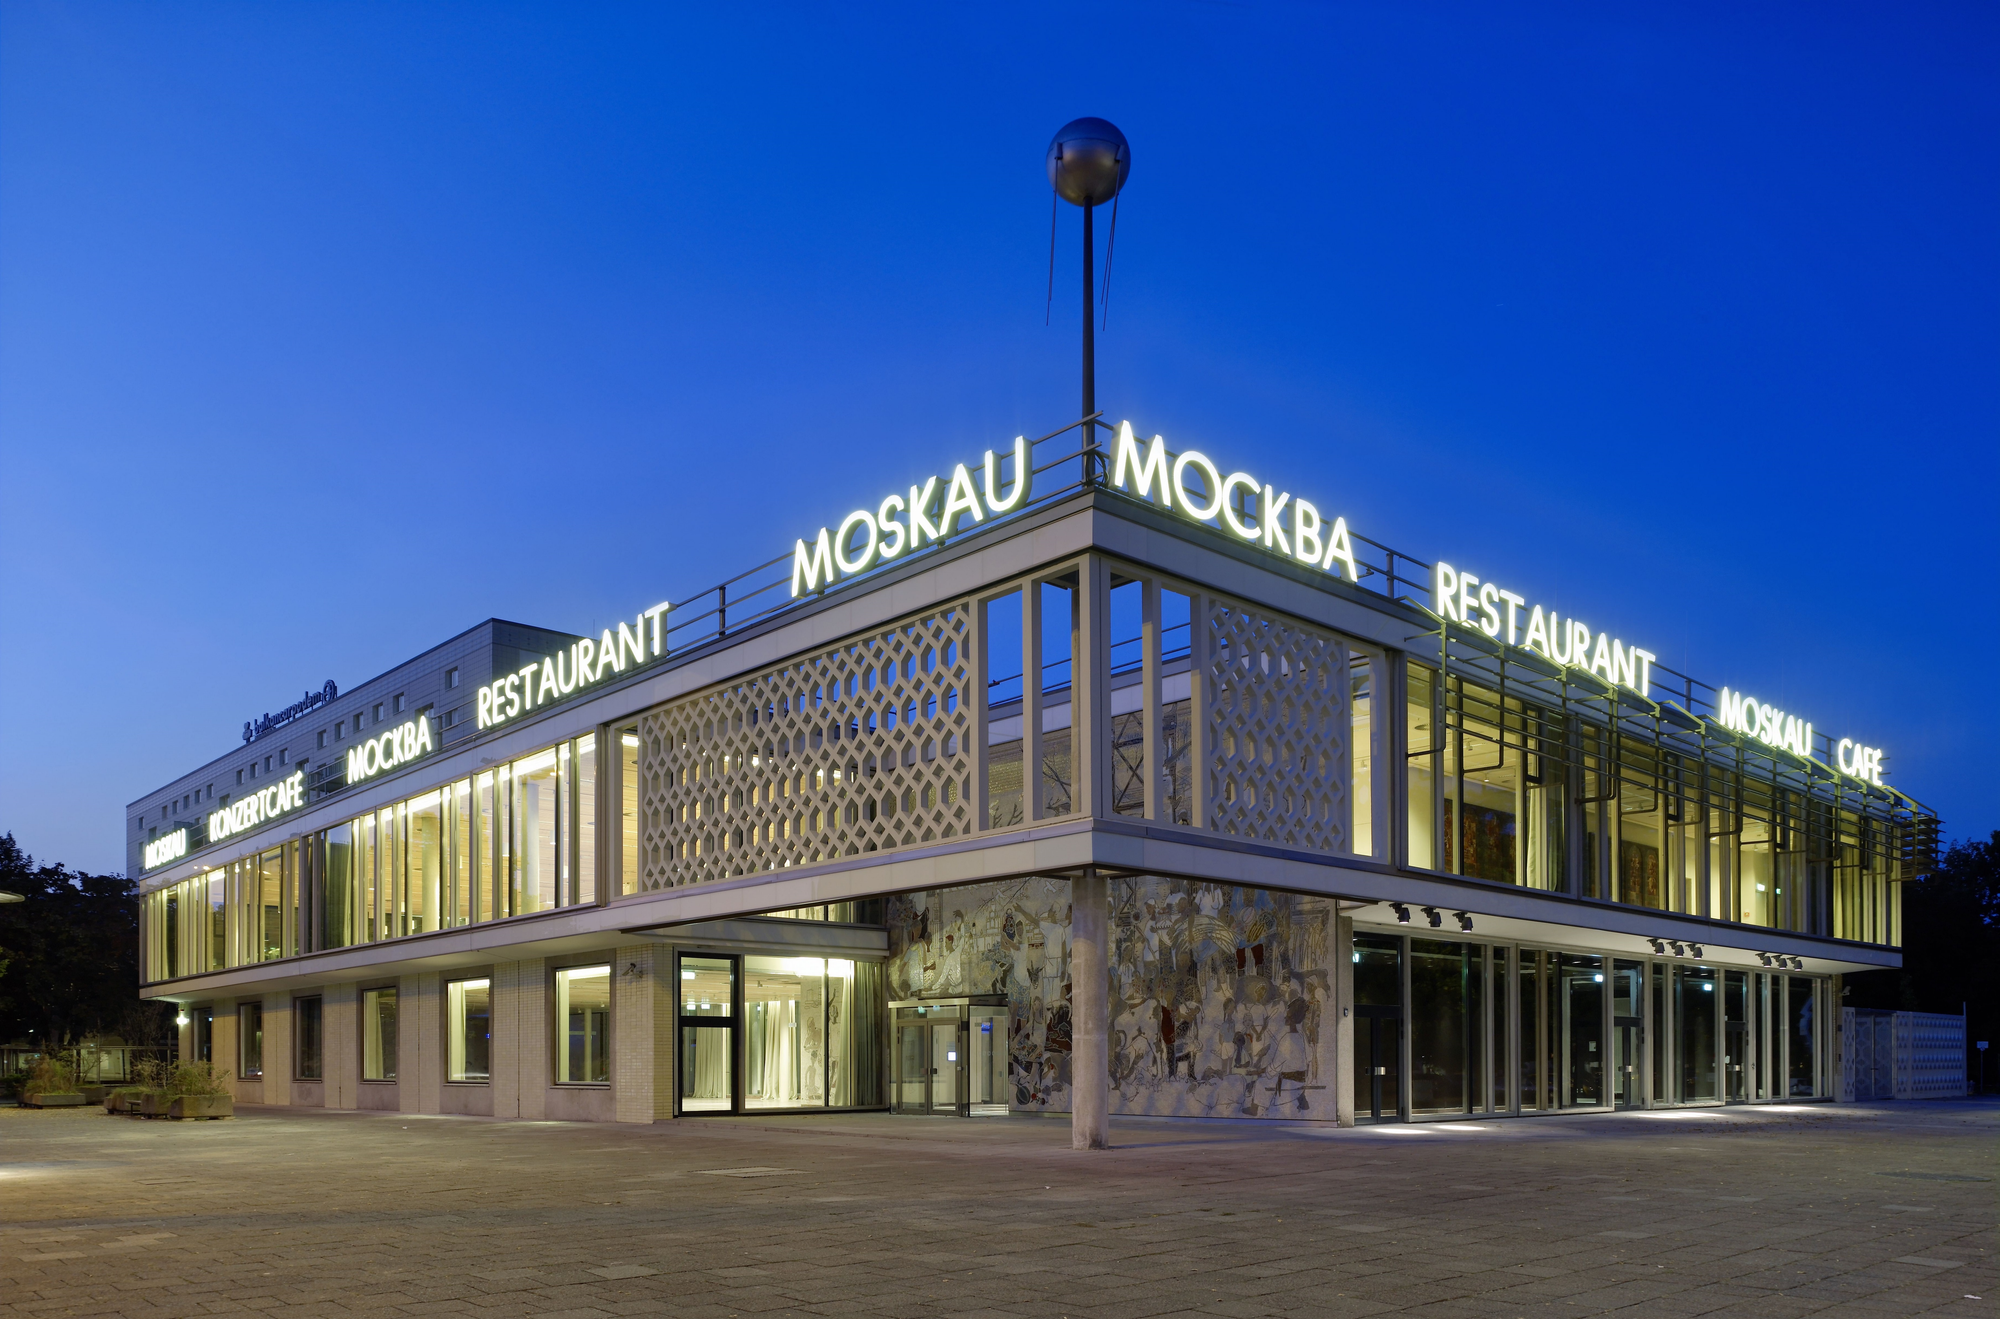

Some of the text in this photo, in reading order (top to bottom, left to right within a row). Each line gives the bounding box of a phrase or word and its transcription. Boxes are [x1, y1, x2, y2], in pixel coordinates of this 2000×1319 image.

[792, 435, 1032, 599] MOSKAU
[1109, 419, 1358, 583] МОСКВА
[478, 601, 676, 730] RESTAURANT
[1432, 561, 1656, 697] RESTAURANT
[347, 715, 432, 785] МОСКВА
[1719, 686, 1812, 757] MOSKAU
[145, 827, 187, 870] MOSKAU
[209, 770, 304, 843] KONZERTCAFÉ
